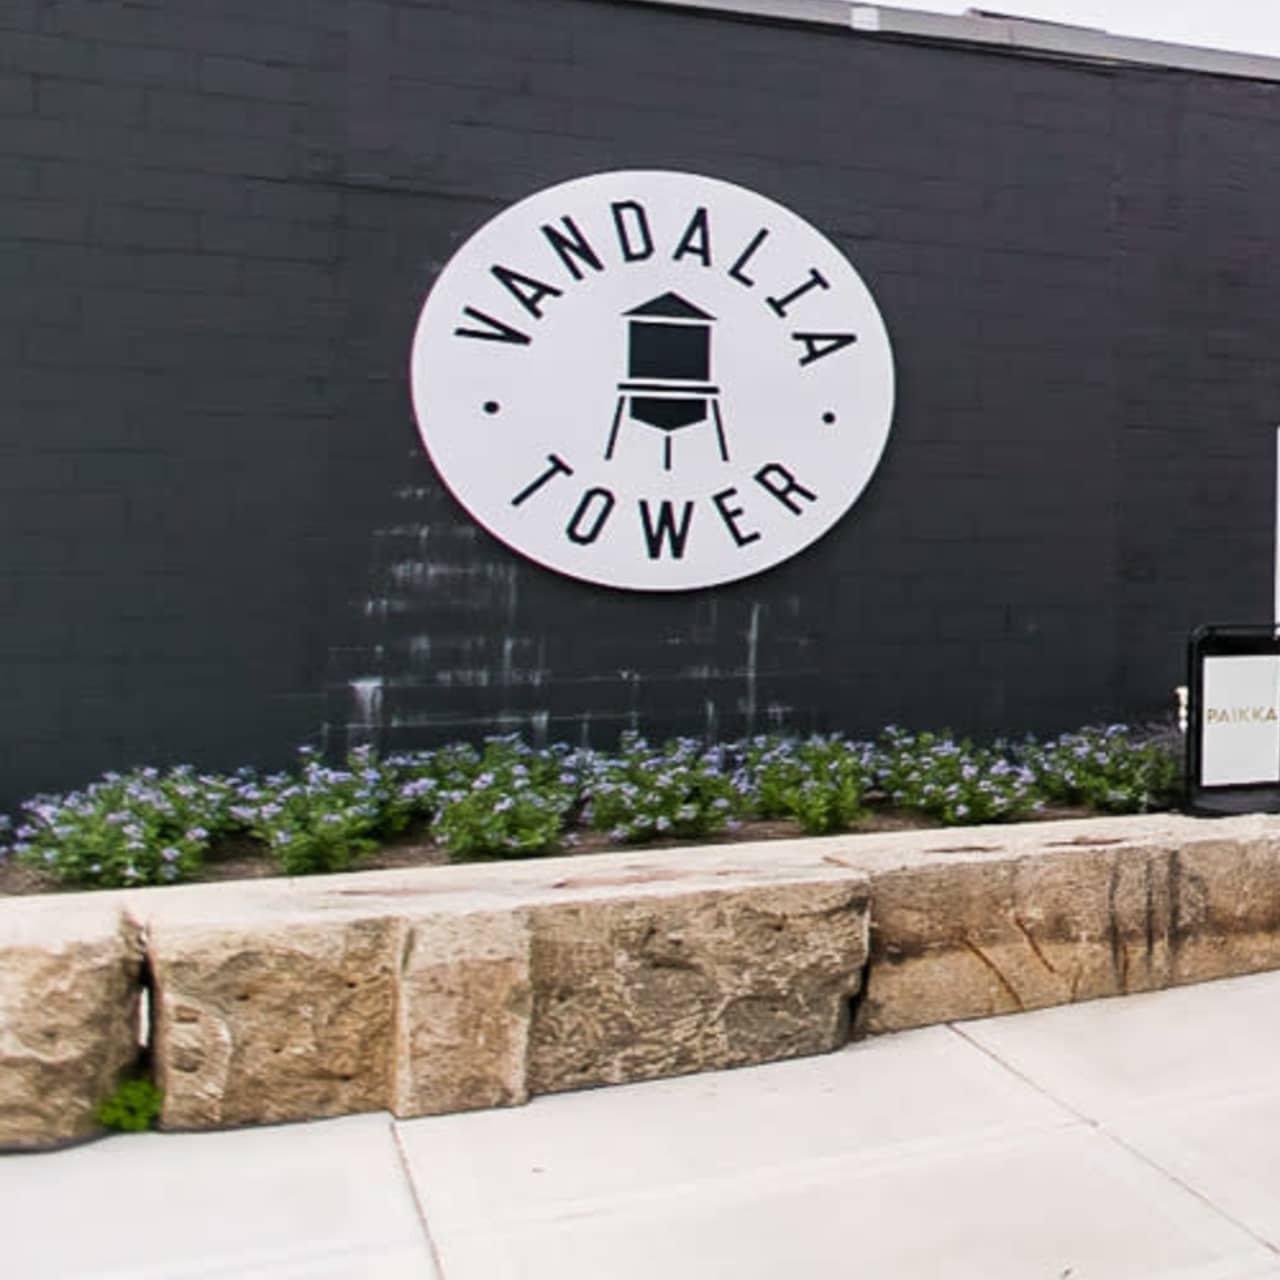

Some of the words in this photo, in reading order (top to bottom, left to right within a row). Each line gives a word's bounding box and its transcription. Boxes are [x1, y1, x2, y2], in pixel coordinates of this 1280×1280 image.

[454, 200, 857, 367] VANDALIA
[511, 453, 818, 560] TOWER
[1207, 706, 1278, 723] PAIKKA
